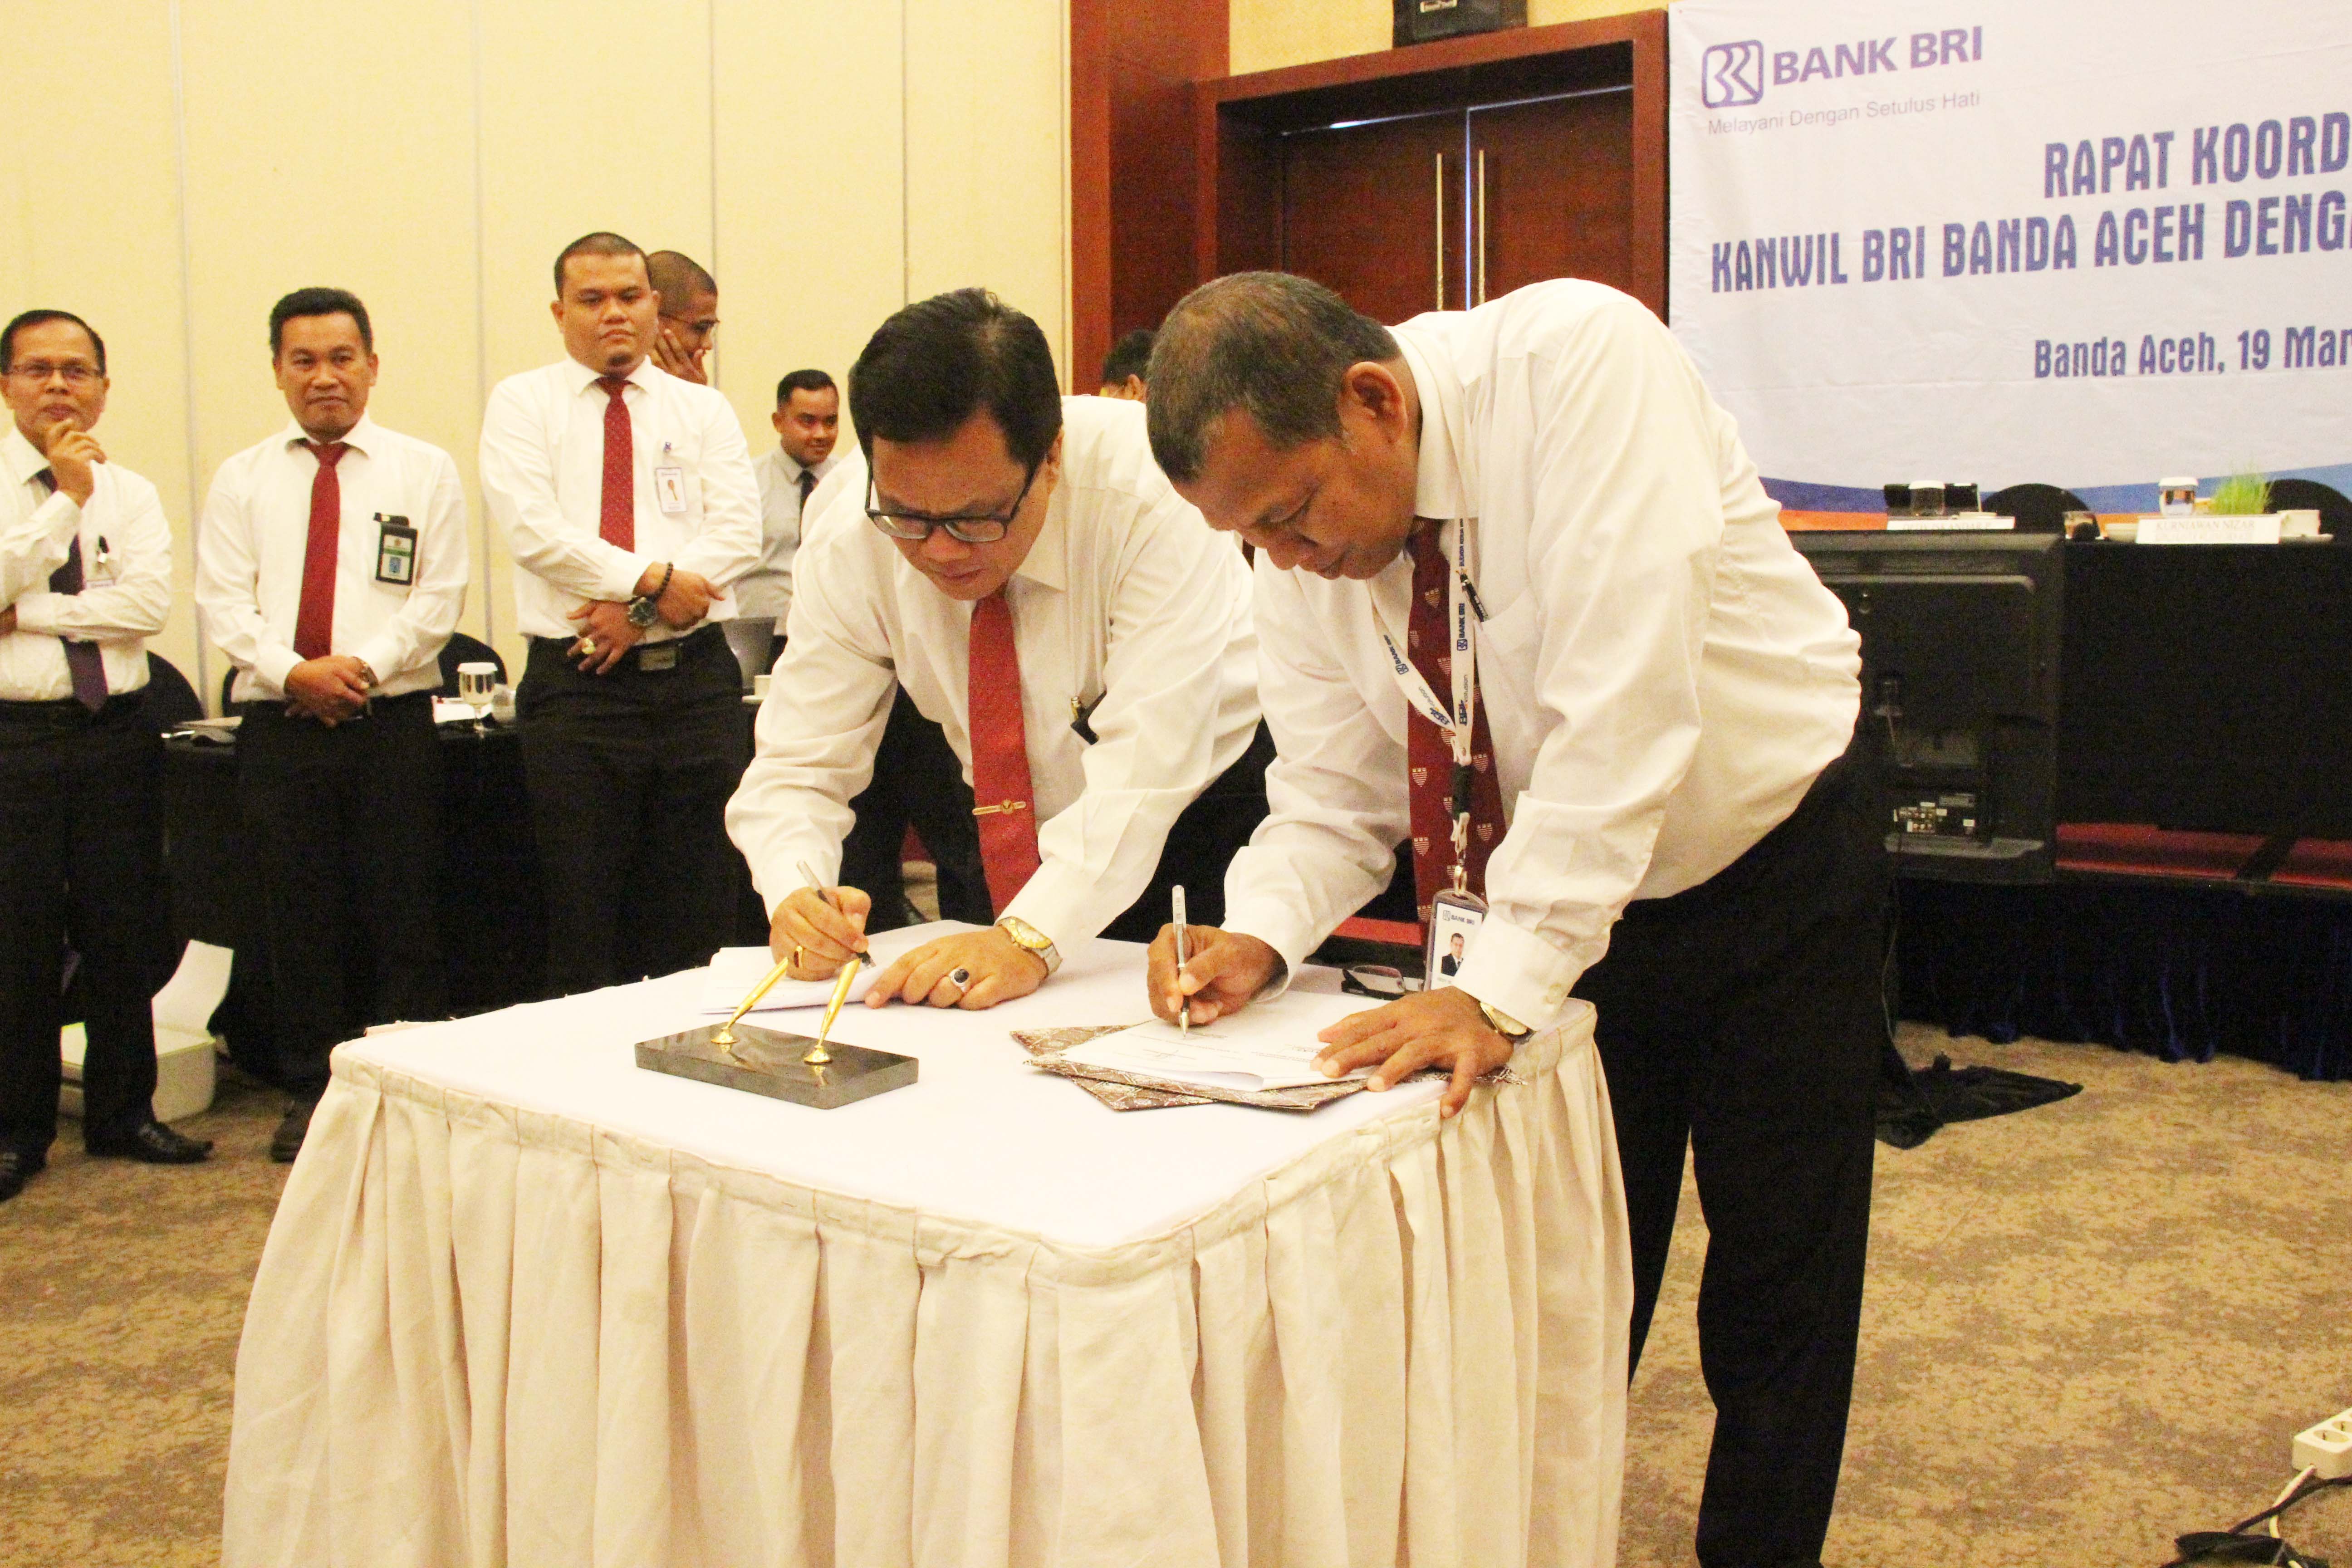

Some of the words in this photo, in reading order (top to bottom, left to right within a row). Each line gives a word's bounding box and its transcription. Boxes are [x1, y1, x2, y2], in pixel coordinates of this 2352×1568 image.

[1774, 37, 1898, 85] BANK
[1911, 26, 1982, 69] BRI
[1708, 115, 1784, 136] Melayani
[1790, 107, 1859, 127] Dengan
[1867, 97, 1935, 118] Setulus
[1943, 91, 1980, 110] Hati
[2044, 131, 2174, 198] RAPAT
[2192, 112, 2350, 185] KOORD
[1712, 232, 1847, 293] KANWIL
[1862, 225, 1925, 282] BRI
[1943, 214, 2077, 277] BANDA
[2094, 203, 2205, 267] ACEH
[2224, 190, 2352, 258] DENG
[2034, 336, 2126, 377] Banda
[2138, 332, 2225, 375] Aceh,
[2237, 328, 2270, 370] 19
[2156, 520, 2219, 530] KURNIAWAN
[1389, 646, 1401, 665] BANK
[1451, 914, 1465, 922] BANK
